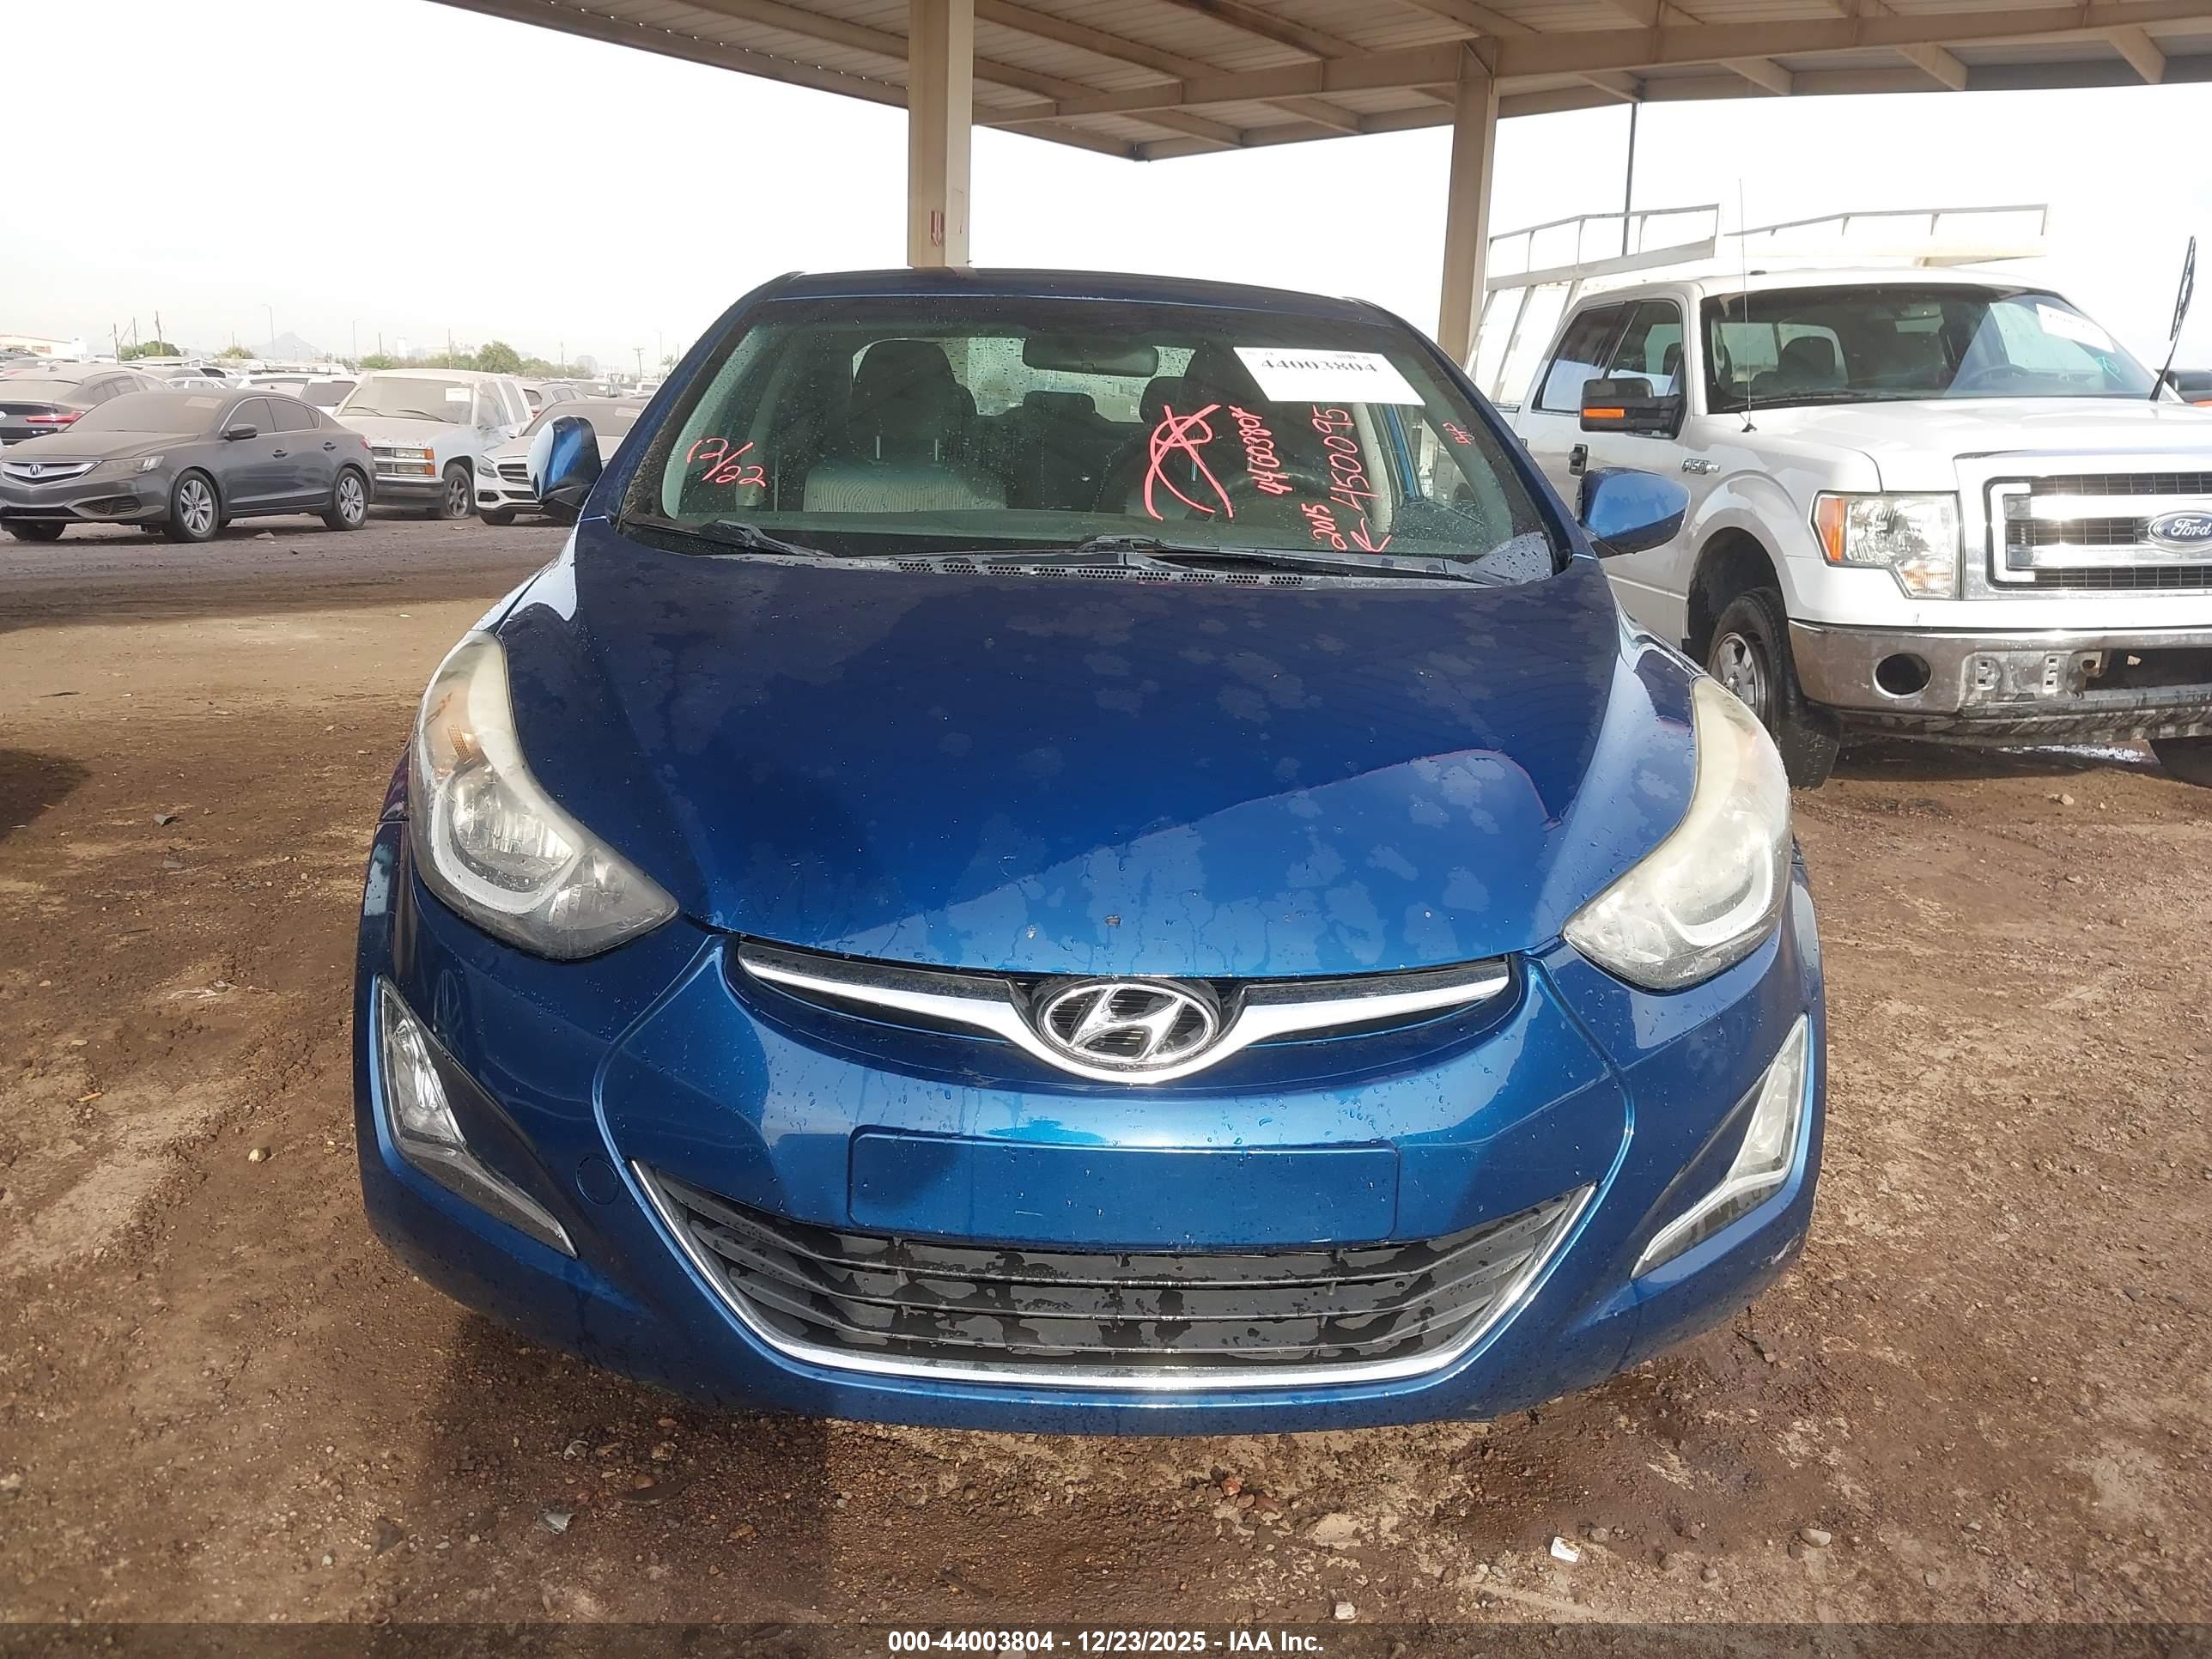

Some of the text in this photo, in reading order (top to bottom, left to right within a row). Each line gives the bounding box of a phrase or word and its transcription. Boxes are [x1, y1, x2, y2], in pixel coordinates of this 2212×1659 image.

[1261, 359, 1378, 373] 44003804
[686, 437, 767, 488] 12/22
[1312, 404, 1379, 513] 450095
[1301, 502, 1347, 552] 2015
[2170, 518, 2212, 538] Ford
